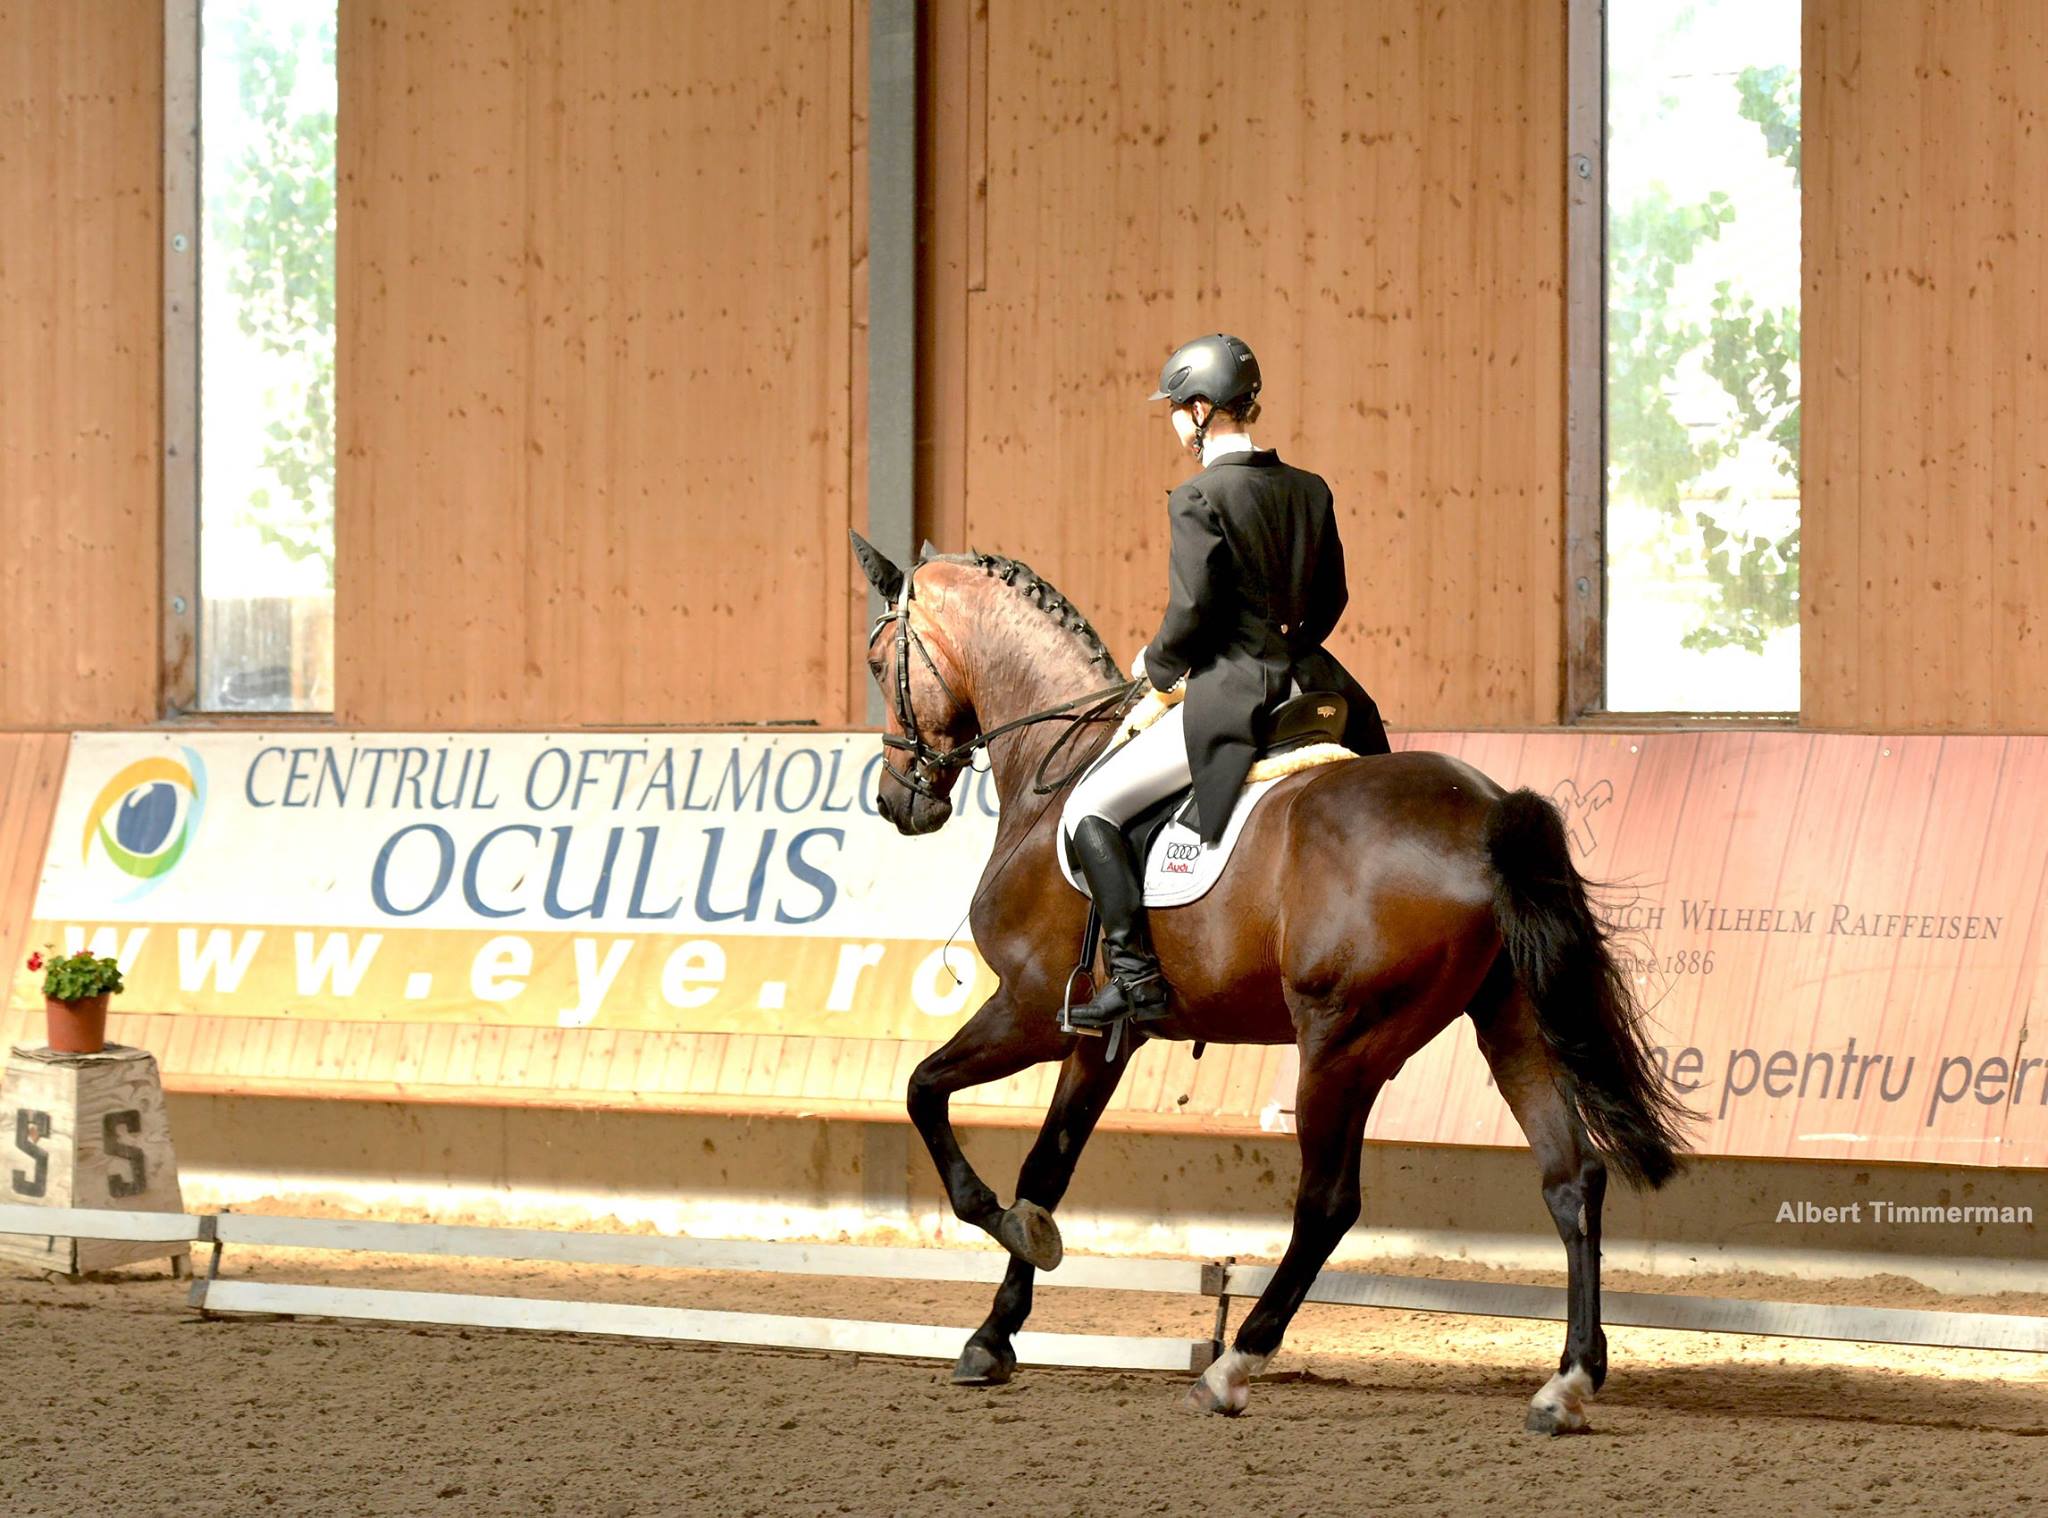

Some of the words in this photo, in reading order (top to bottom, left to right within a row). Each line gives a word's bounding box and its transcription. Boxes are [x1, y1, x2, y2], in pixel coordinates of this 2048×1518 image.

[246, 746, 498, 809] CENTRUL
[371, 823, 846, 924] OCULUS
[1167, 862, 1189, 873] Audi
[1664, 950, 1716, 975] 1886
[1718, 1036, 1916, 1121] pentru
[11, 1108, 51, 1198] S
[102, 1109, 147, 1198] S
